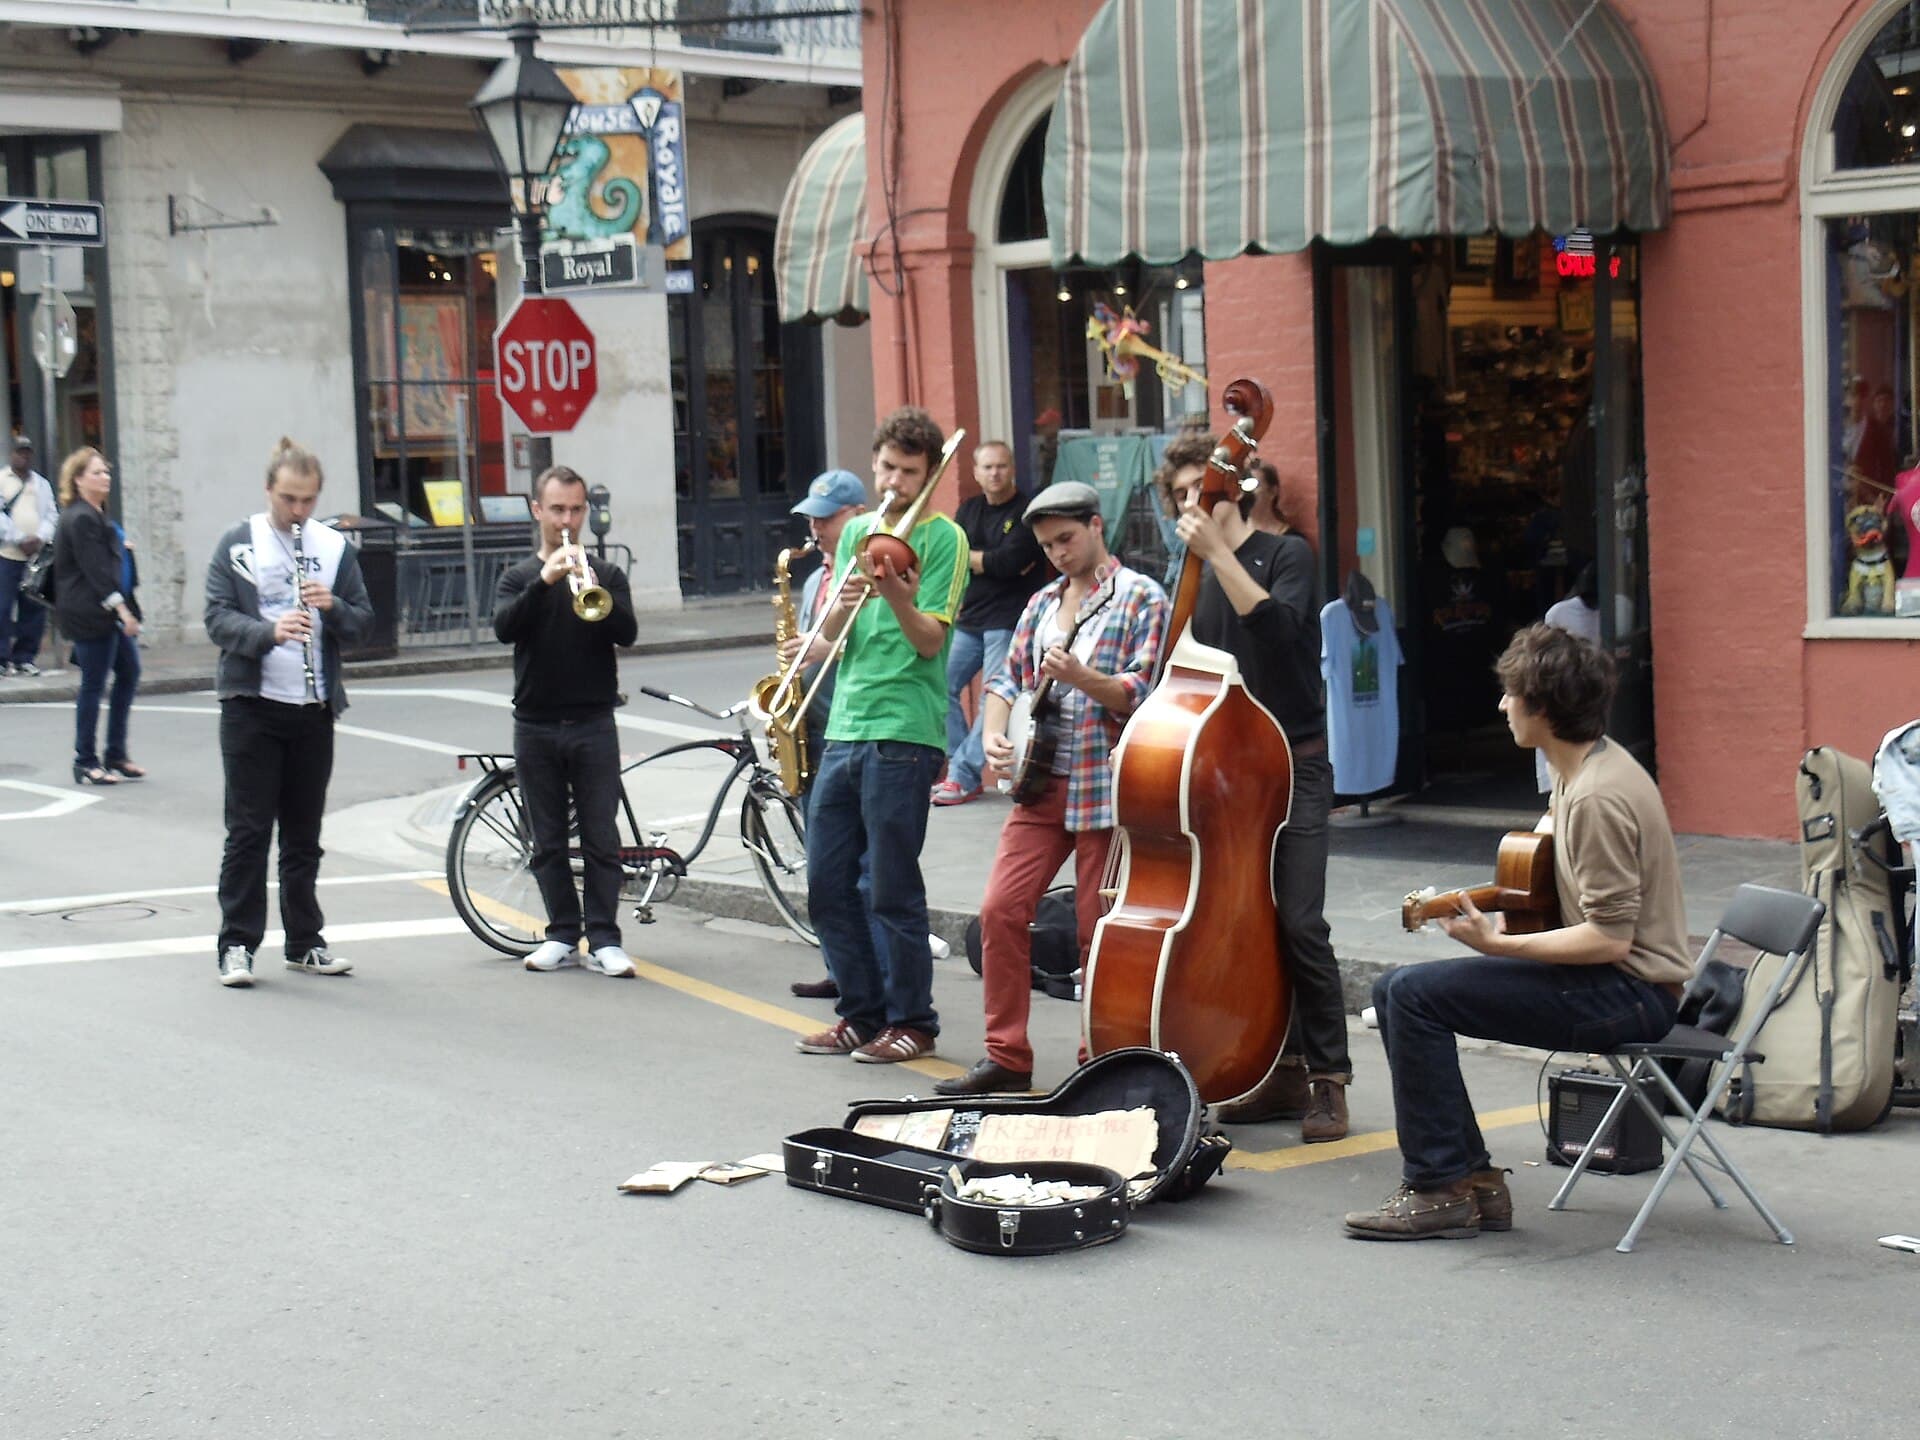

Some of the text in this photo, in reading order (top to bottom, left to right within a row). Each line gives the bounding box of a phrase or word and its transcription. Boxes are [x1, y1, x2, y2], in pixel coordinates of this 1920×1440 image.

[657, 115, 682, 236] Royale
[25, 214, 57, 231] ONE
[562, 253, 613, 287] Royal
[504, 340, 592, 393] STOP
